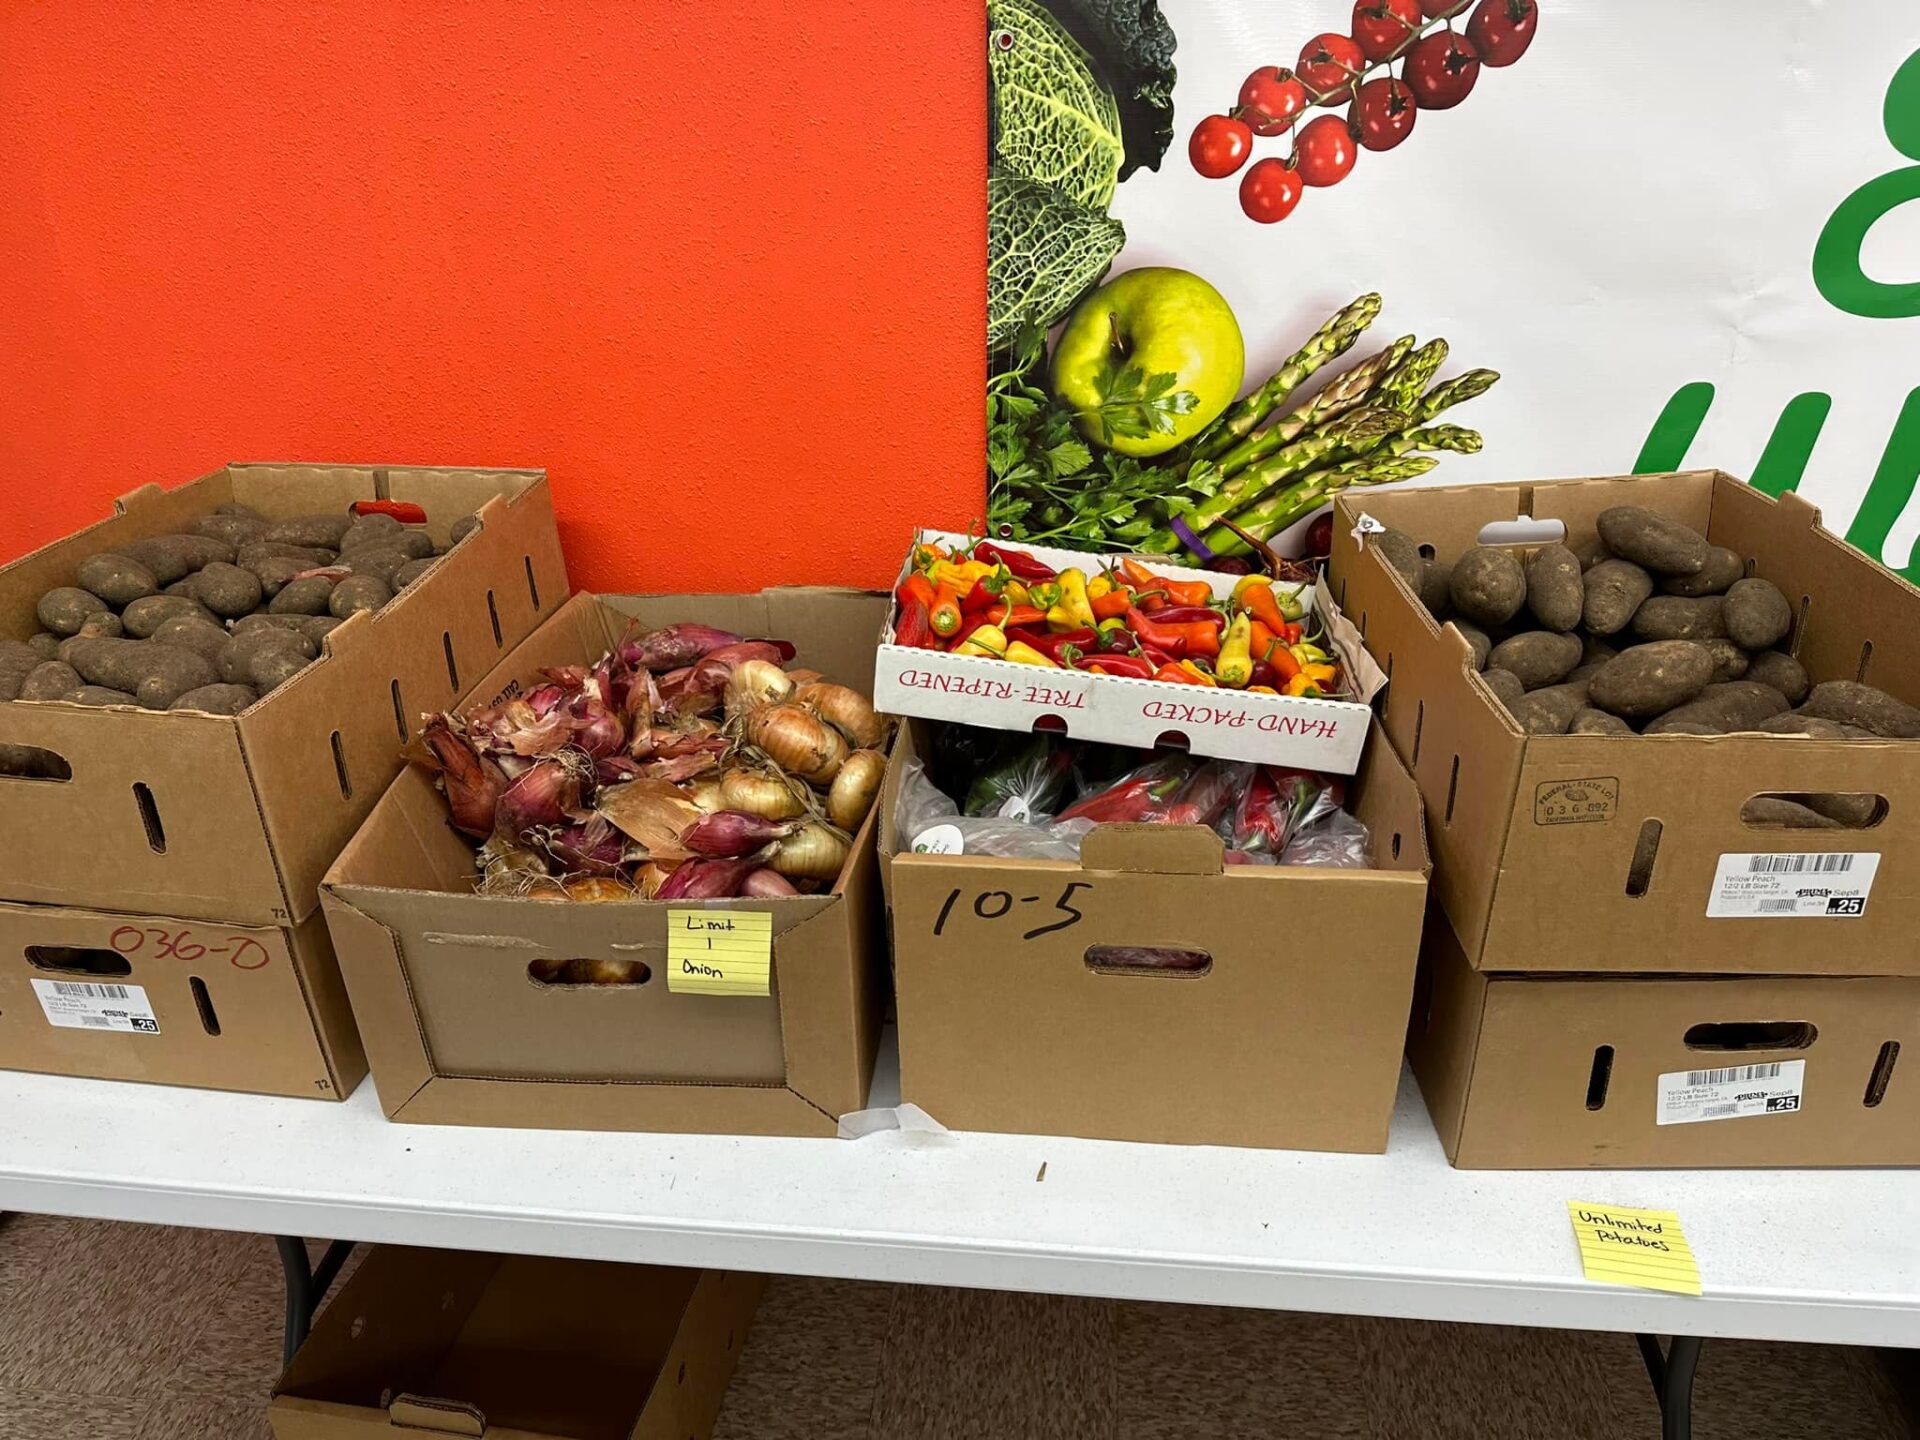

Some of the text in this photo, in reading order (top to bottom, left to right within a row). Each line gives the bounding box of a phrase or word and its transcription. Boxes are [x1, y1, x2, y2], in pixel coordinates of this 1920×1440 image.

[898, 669, 1338, 739] HAND-PACKED TREE-RIPENED
[271, 908, 287, 919] 72
[933, 882, 1094, 940] 10-5
[1837, 899, 1861, 914] 25
[687, 915, 736, 931] Limit
[682, 958, 723, 979] Onion
[138, 1020, 156, 1031] 25
[314, 1079, 330, 1090] 72
[1775, 1097, 1796, 1110] 25
[1579, 1210, 1663, 1234] Unlimited
